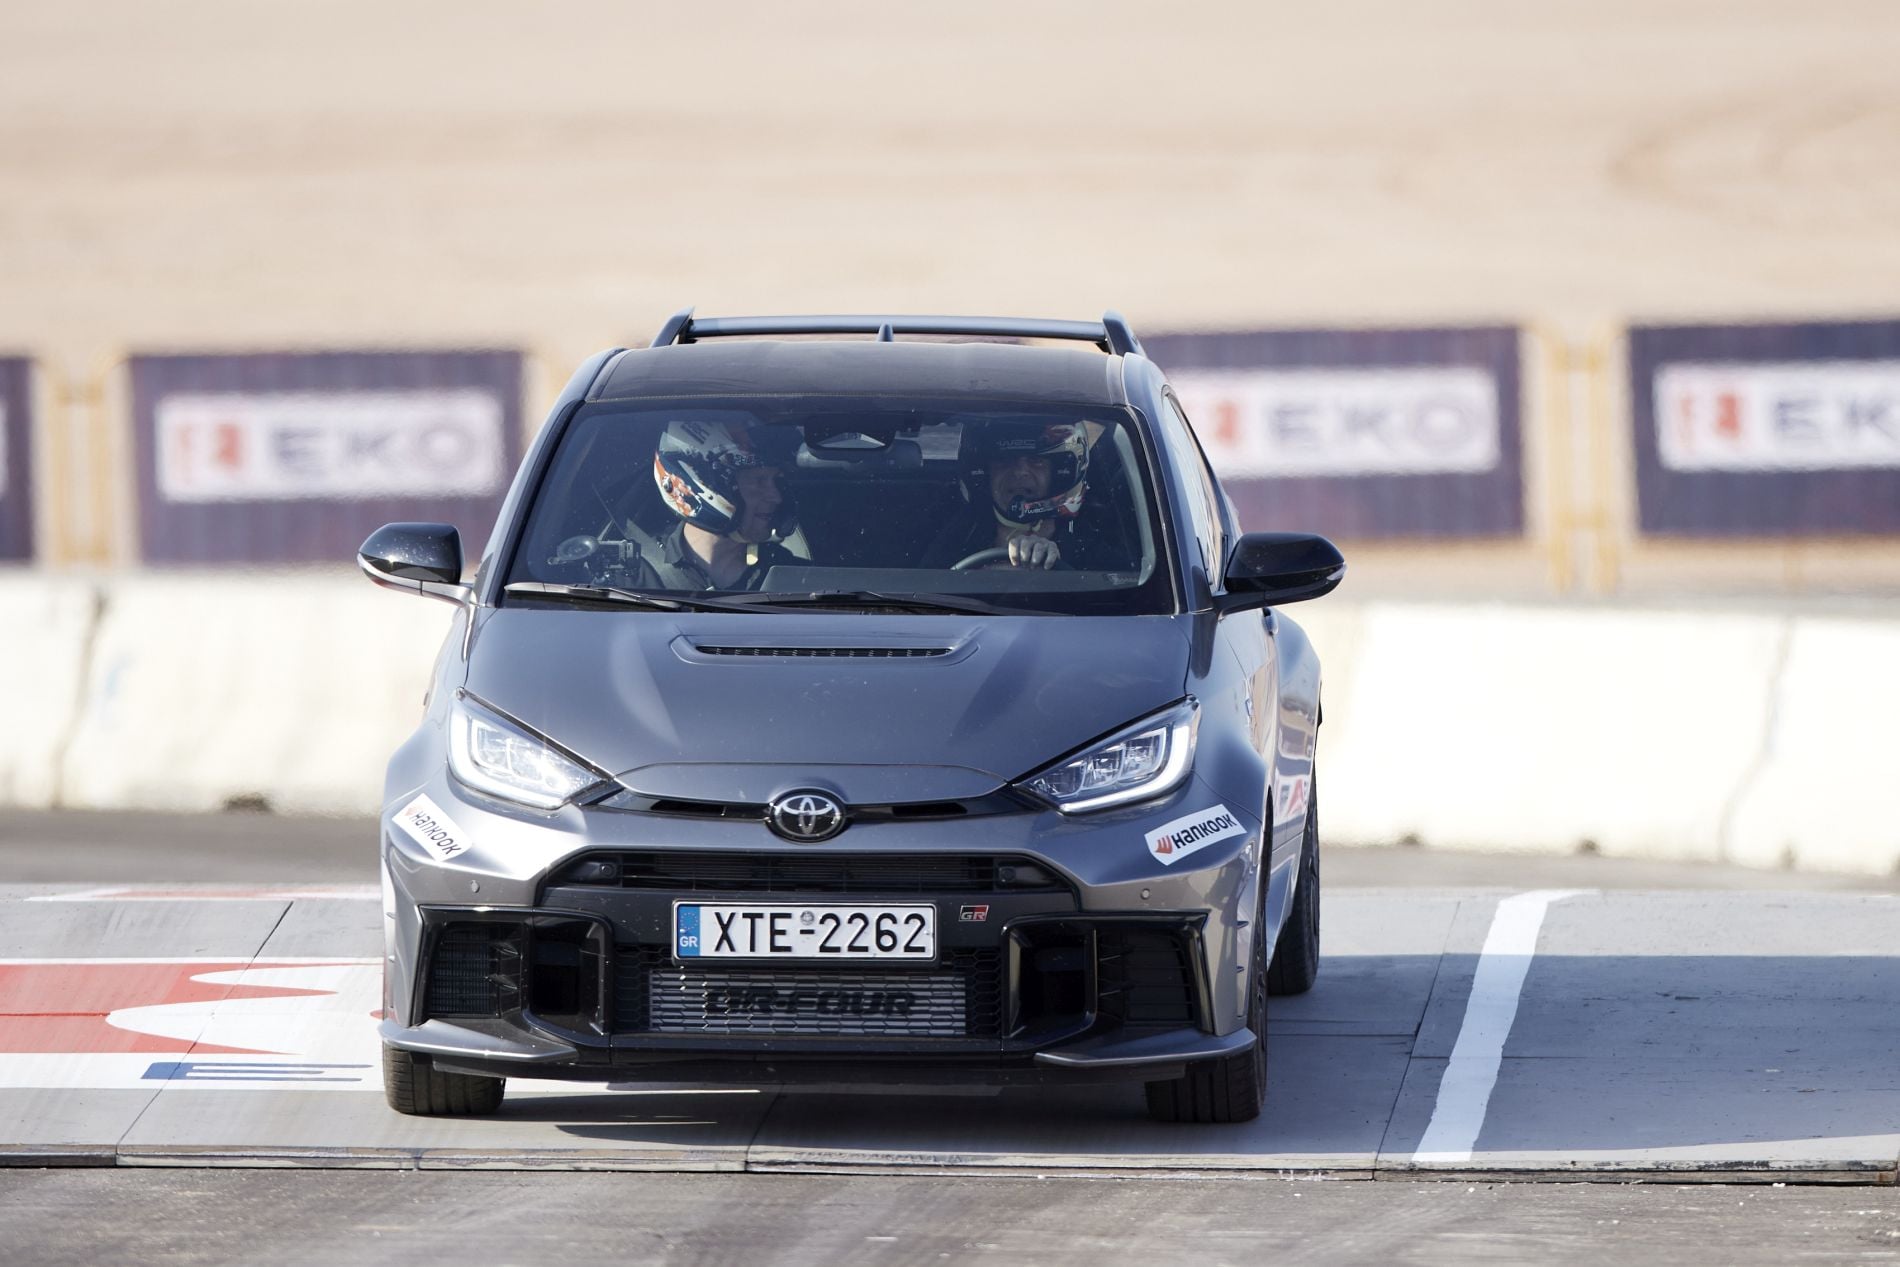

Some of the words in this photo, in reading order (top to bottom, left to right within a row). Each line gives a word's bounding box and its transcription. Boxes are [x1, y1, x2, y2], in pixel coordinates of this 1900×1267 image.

[1264, 397, 1474, 450] EKO
[269, 416, 477, 476] EKO
[714, 911, 926, 953] XTE-2262
[960, 911, 986, 920] GR
[679, 935, 698, 947] GR
